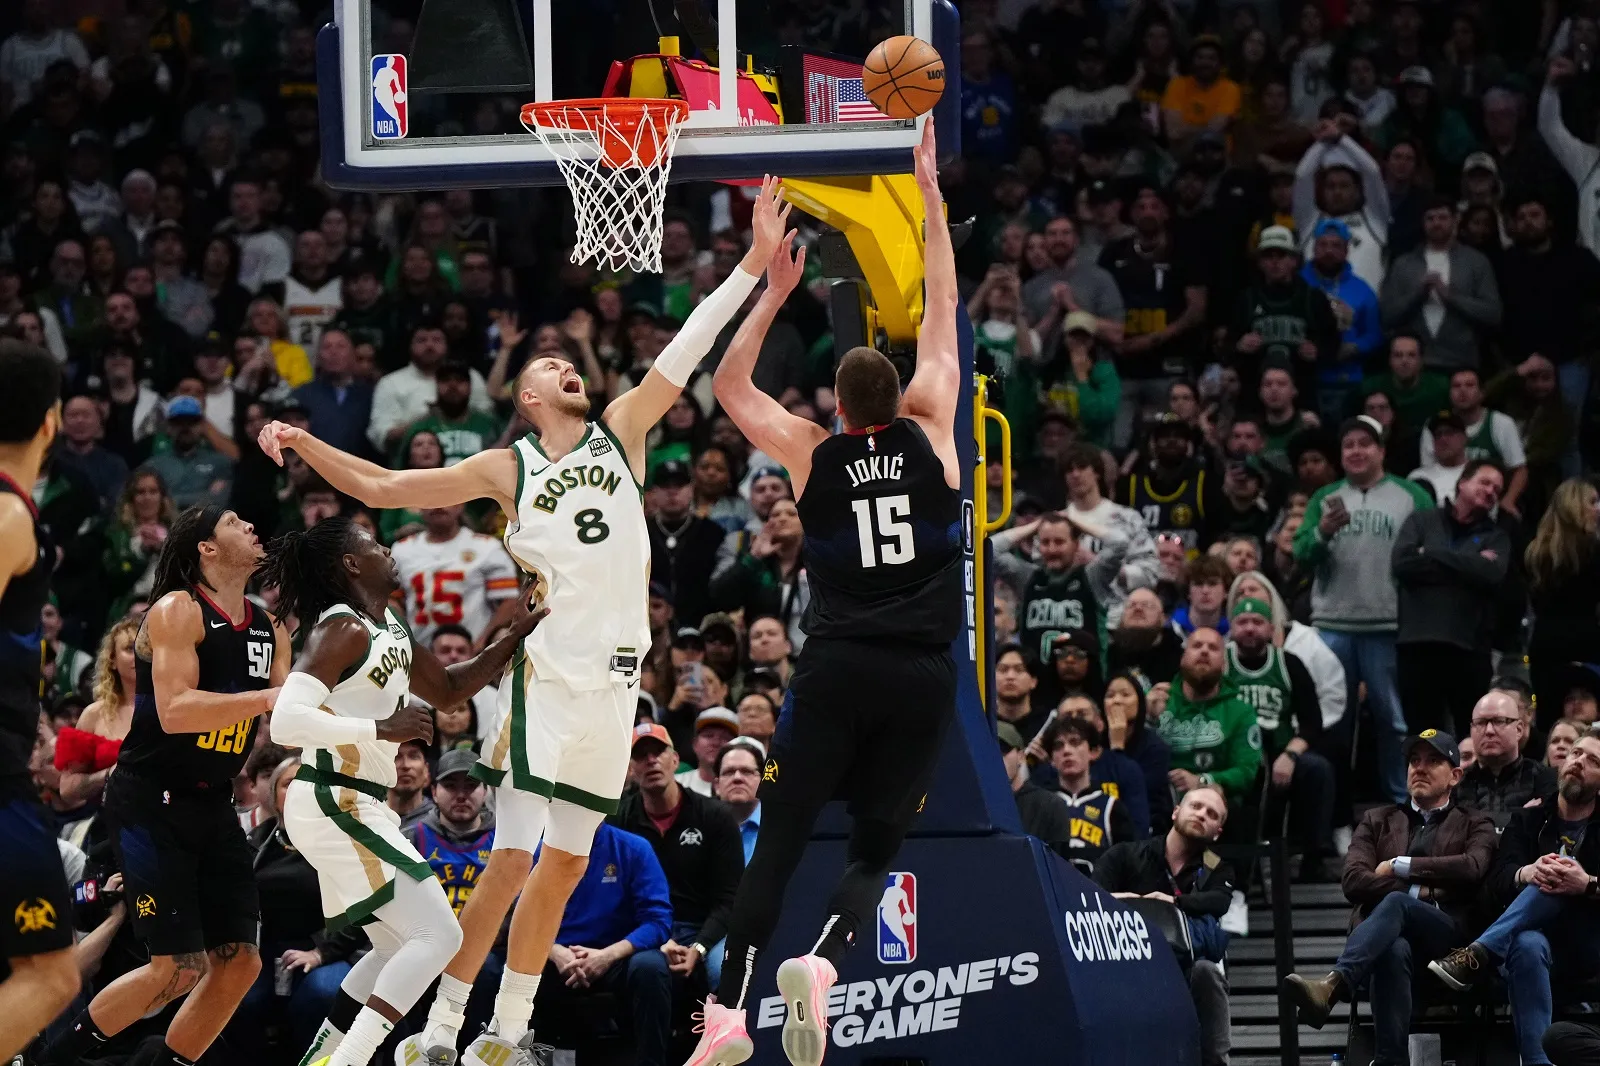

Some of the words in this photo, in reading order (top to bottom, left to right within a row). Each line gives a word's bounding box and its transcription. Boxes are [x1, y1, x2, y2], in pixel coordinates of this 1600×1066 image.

[376, 120, 394, 134] NBA
[589, 438, 609, 449] VISTA
[591, 445, 611, 457] PRINT
[533, 465, 622, 514] BOSTON
[845, 453, 904, 488] JOKIĆ
[574, 508, 610, 544] 8
[851, 494, 916, 568] 15
[410, 571, 464, 626] 15
[247, 641, 273, 680] 50
[367, 646, 410, 690] BOSTO
[1069, 818, 1104, 847] VER
[1065, 892, 1152, 962] coinbase
[883, 943, 902, 958] NBA
[757, 952, 1040, 1029] EERYONE'S
[831, 997, 962, 1048] GAME
